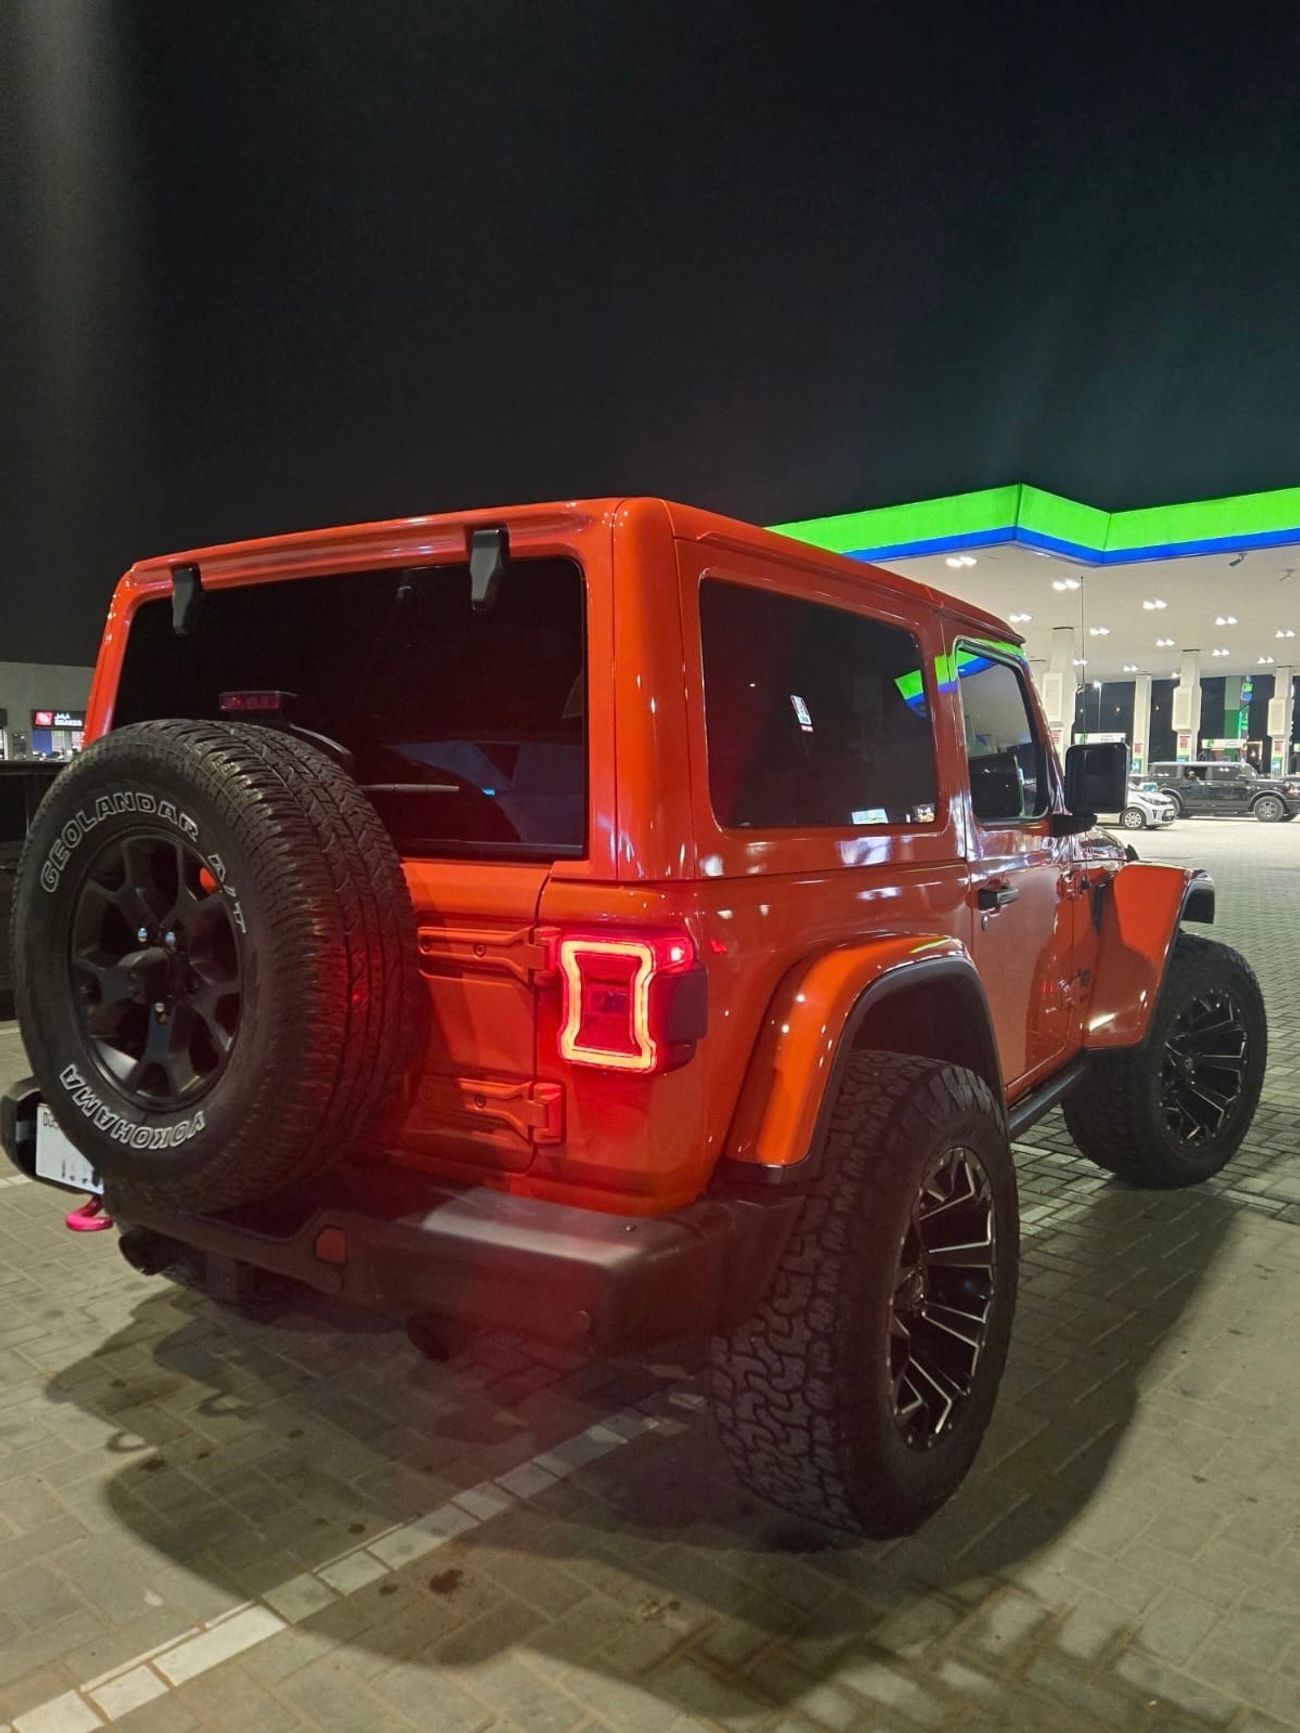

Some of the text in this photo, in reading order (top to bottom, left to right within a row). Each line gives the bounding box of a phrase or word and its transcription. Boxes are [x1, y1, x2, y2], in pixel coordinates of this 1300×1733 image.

[40, 792, 247, 933] GEOLANDAR A/T
[60, 1064, 205, 1149] YOKOHAMA
